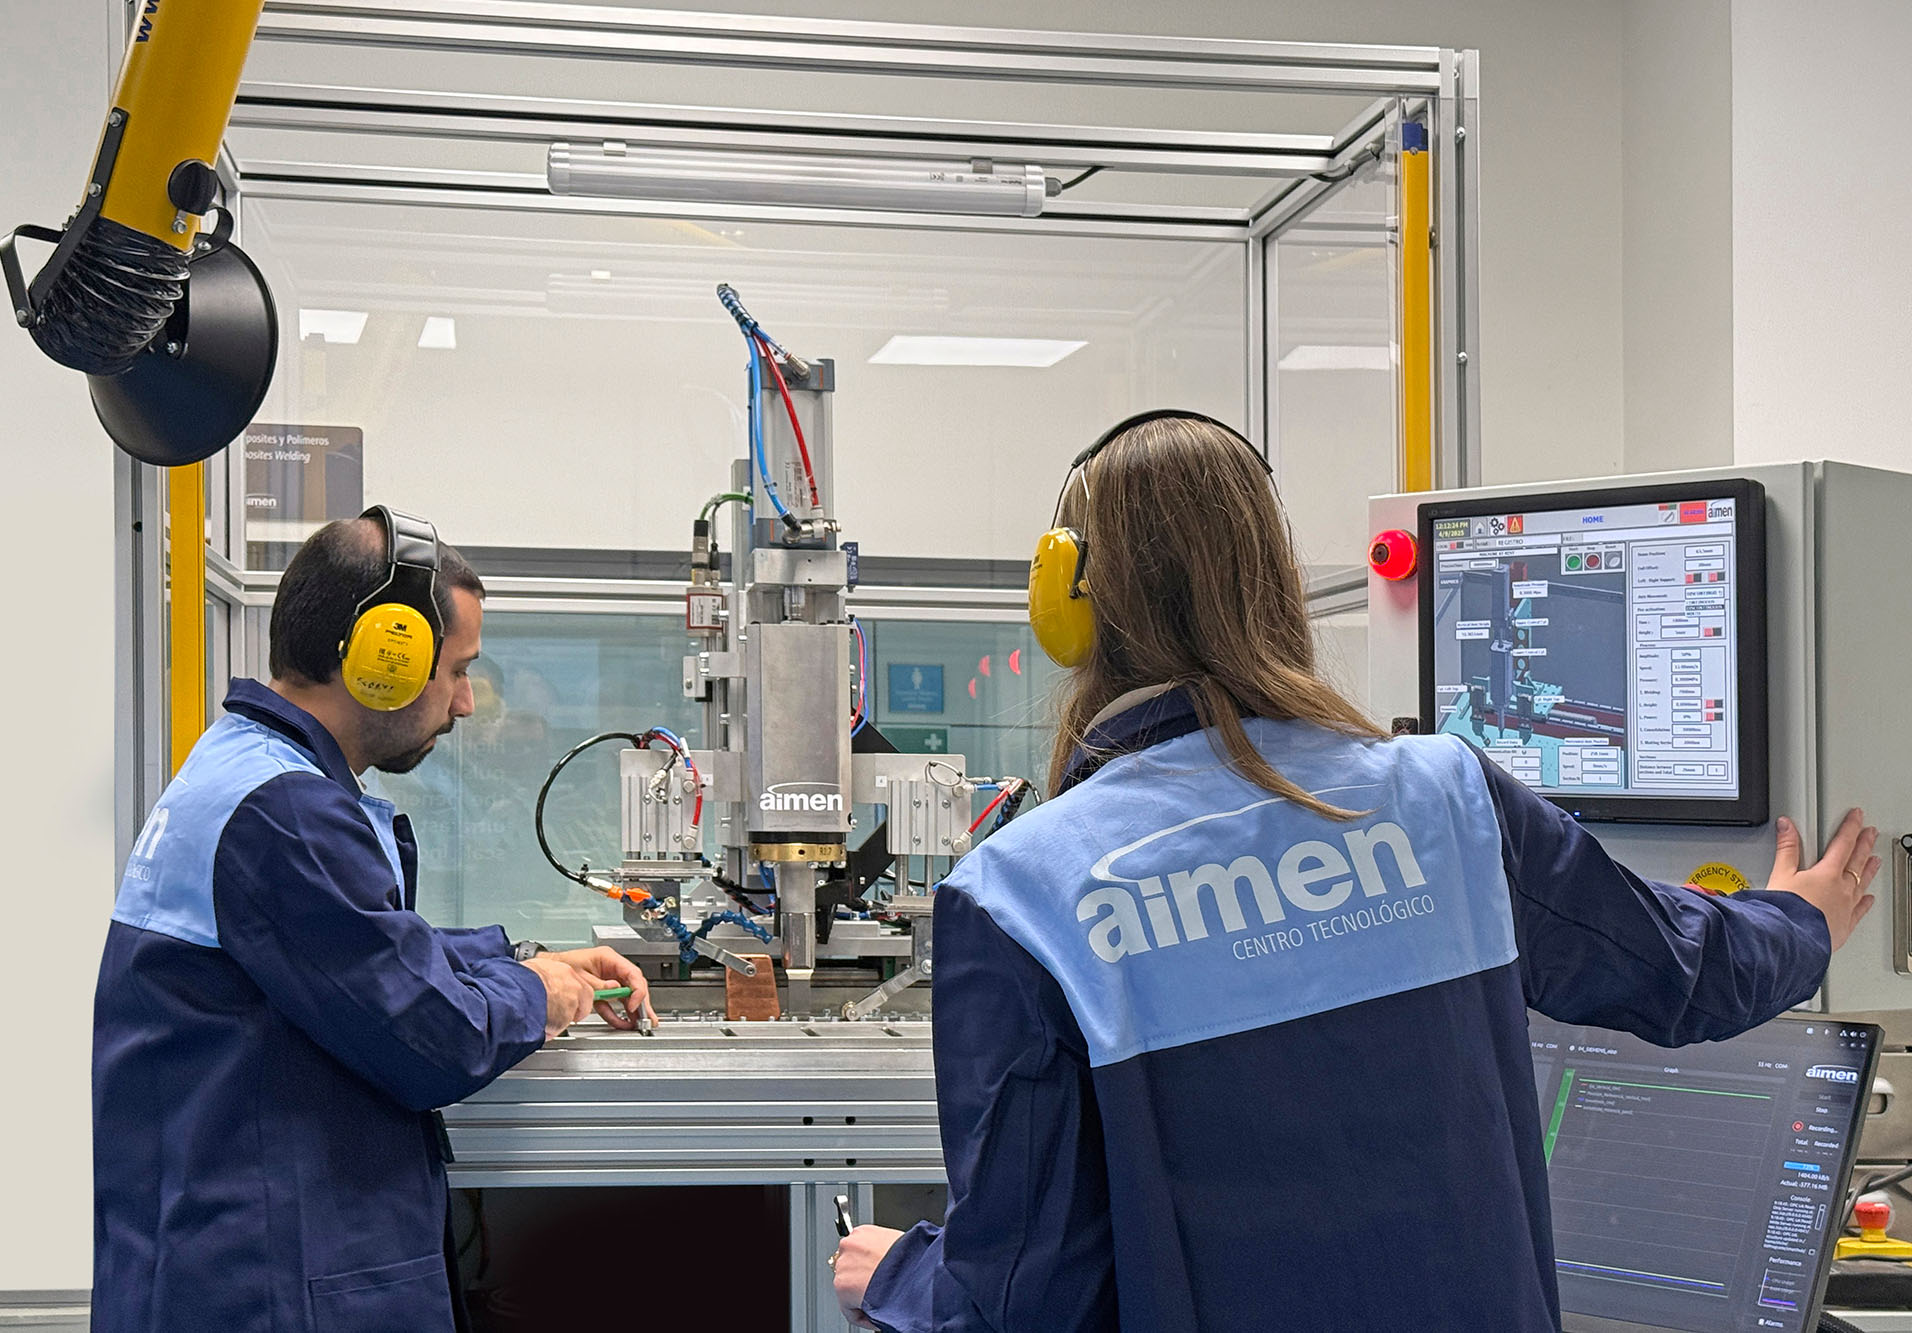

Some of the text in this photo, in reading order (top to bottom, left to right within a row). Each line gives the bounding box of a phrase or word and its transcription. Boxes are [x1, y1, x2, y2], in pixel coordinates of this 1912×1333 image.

[275, 451, 311, 464] Welding
[1582, 516, 1604, 524] HOME
[392, 622, 407, 632] 3M
[759, 793, 843, 811] aimen
[1076, 821, 1427, 964] aimen
[1232, 893, 1435, 961] CENTRO TECNOLÓGICO
[1663, 1066, 1680, 1074] Graph
[1805, 1067, 1859, 1081] aimen
[1815, 1106, 1828, 1114] Stop
[1813, 1140, 1840, 1149] Recorded
[1790, 1194, 1812, 1203] Console
[1768, 1256, 1803, 1267] Performance
[1764, 1319, 1784, 1328] Alarms
